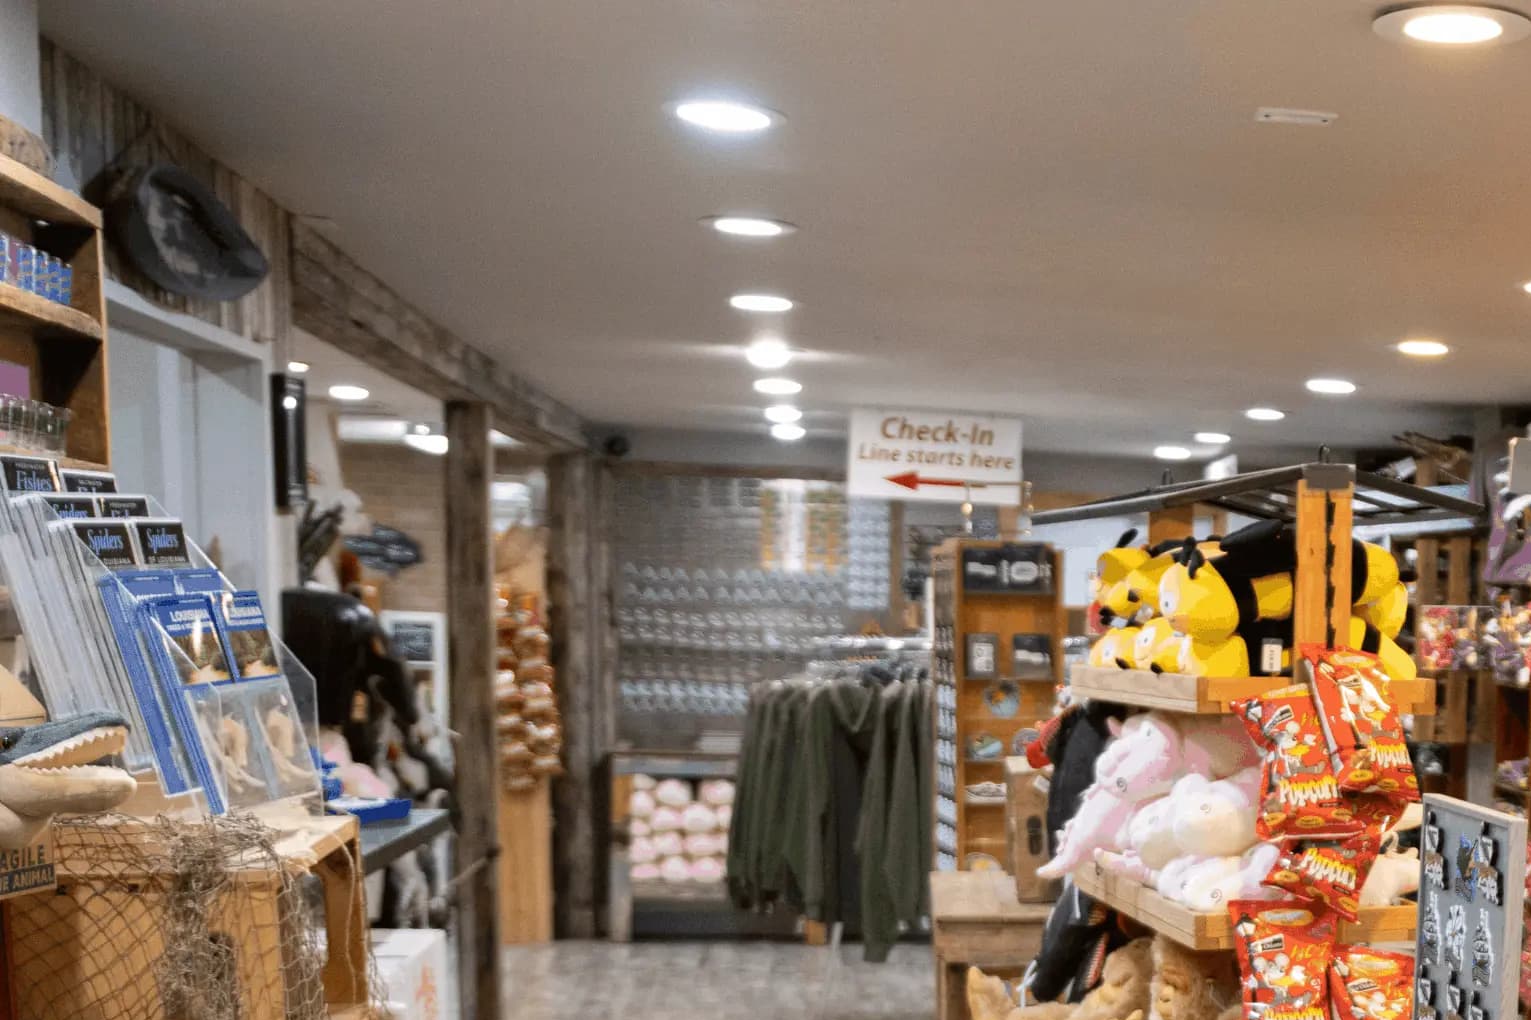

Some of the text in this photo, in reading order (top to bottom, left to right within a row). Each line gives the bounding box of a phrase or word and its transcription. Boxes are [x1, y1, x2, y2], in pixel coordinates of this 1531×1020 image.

[880, 416, 995, 446] Check-In
[858, 442, 1016, 470] Line starts here
[15, 469, 53, 492] Fishes
[87, 527, 124, 555] Spiders
[146, 527, 178, 554] Spiders
